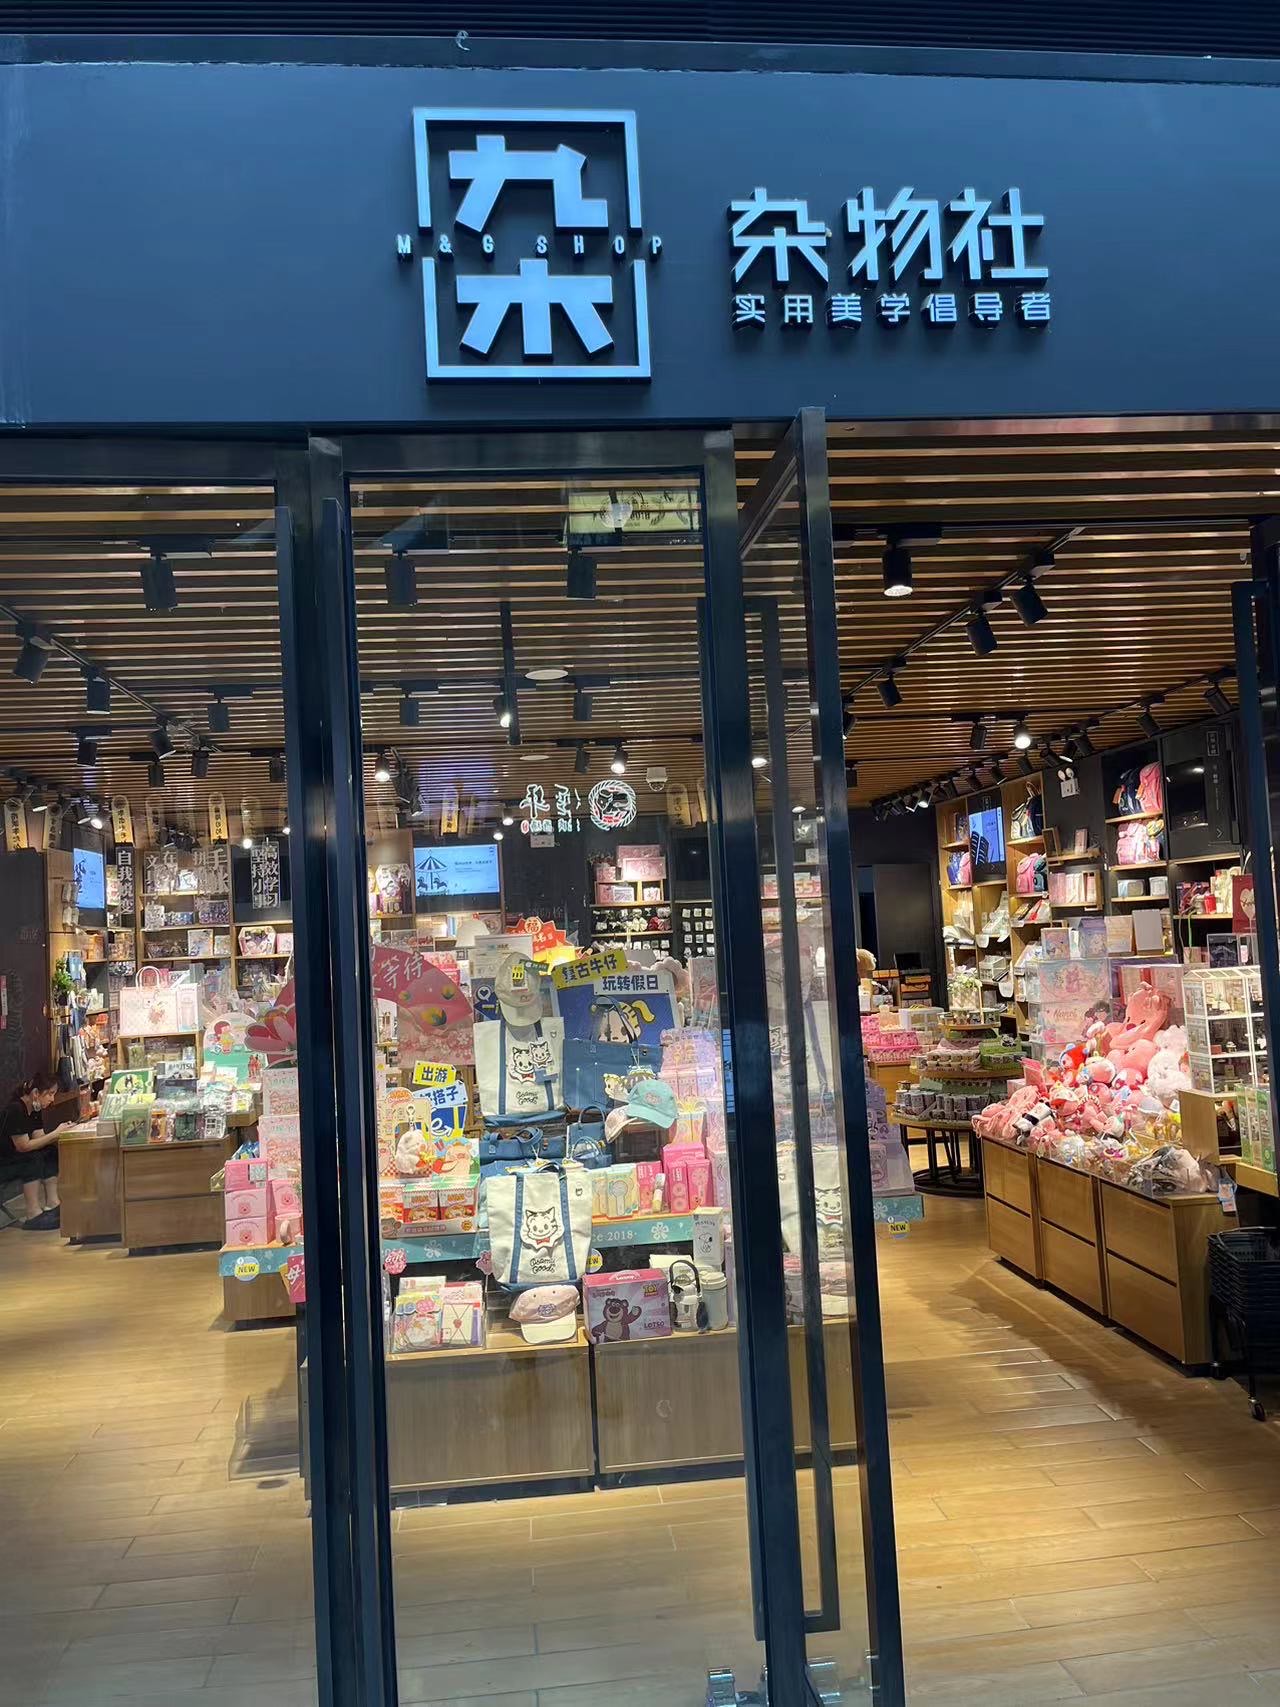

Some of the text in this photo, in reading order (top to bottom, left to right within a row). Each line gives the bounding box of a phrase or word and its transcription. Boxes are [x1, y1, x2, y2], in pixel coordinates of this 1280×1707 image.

[730, 186, 1050, 283] 杂物社
[535, 234, 662, 255] SHOP
[733, 292, 1053, 325] 实用美学倡导者
[602, 974, 660, 992] 玩转假日
[421, 1065, 449, 1083] 出游
[607, 1230, 635, 1241] 2018
[890, 1224, 907, 1232] NEW
[237, 1264, 257, 1274] NEW
[643, 1320, 665, 1329] LOTSO
